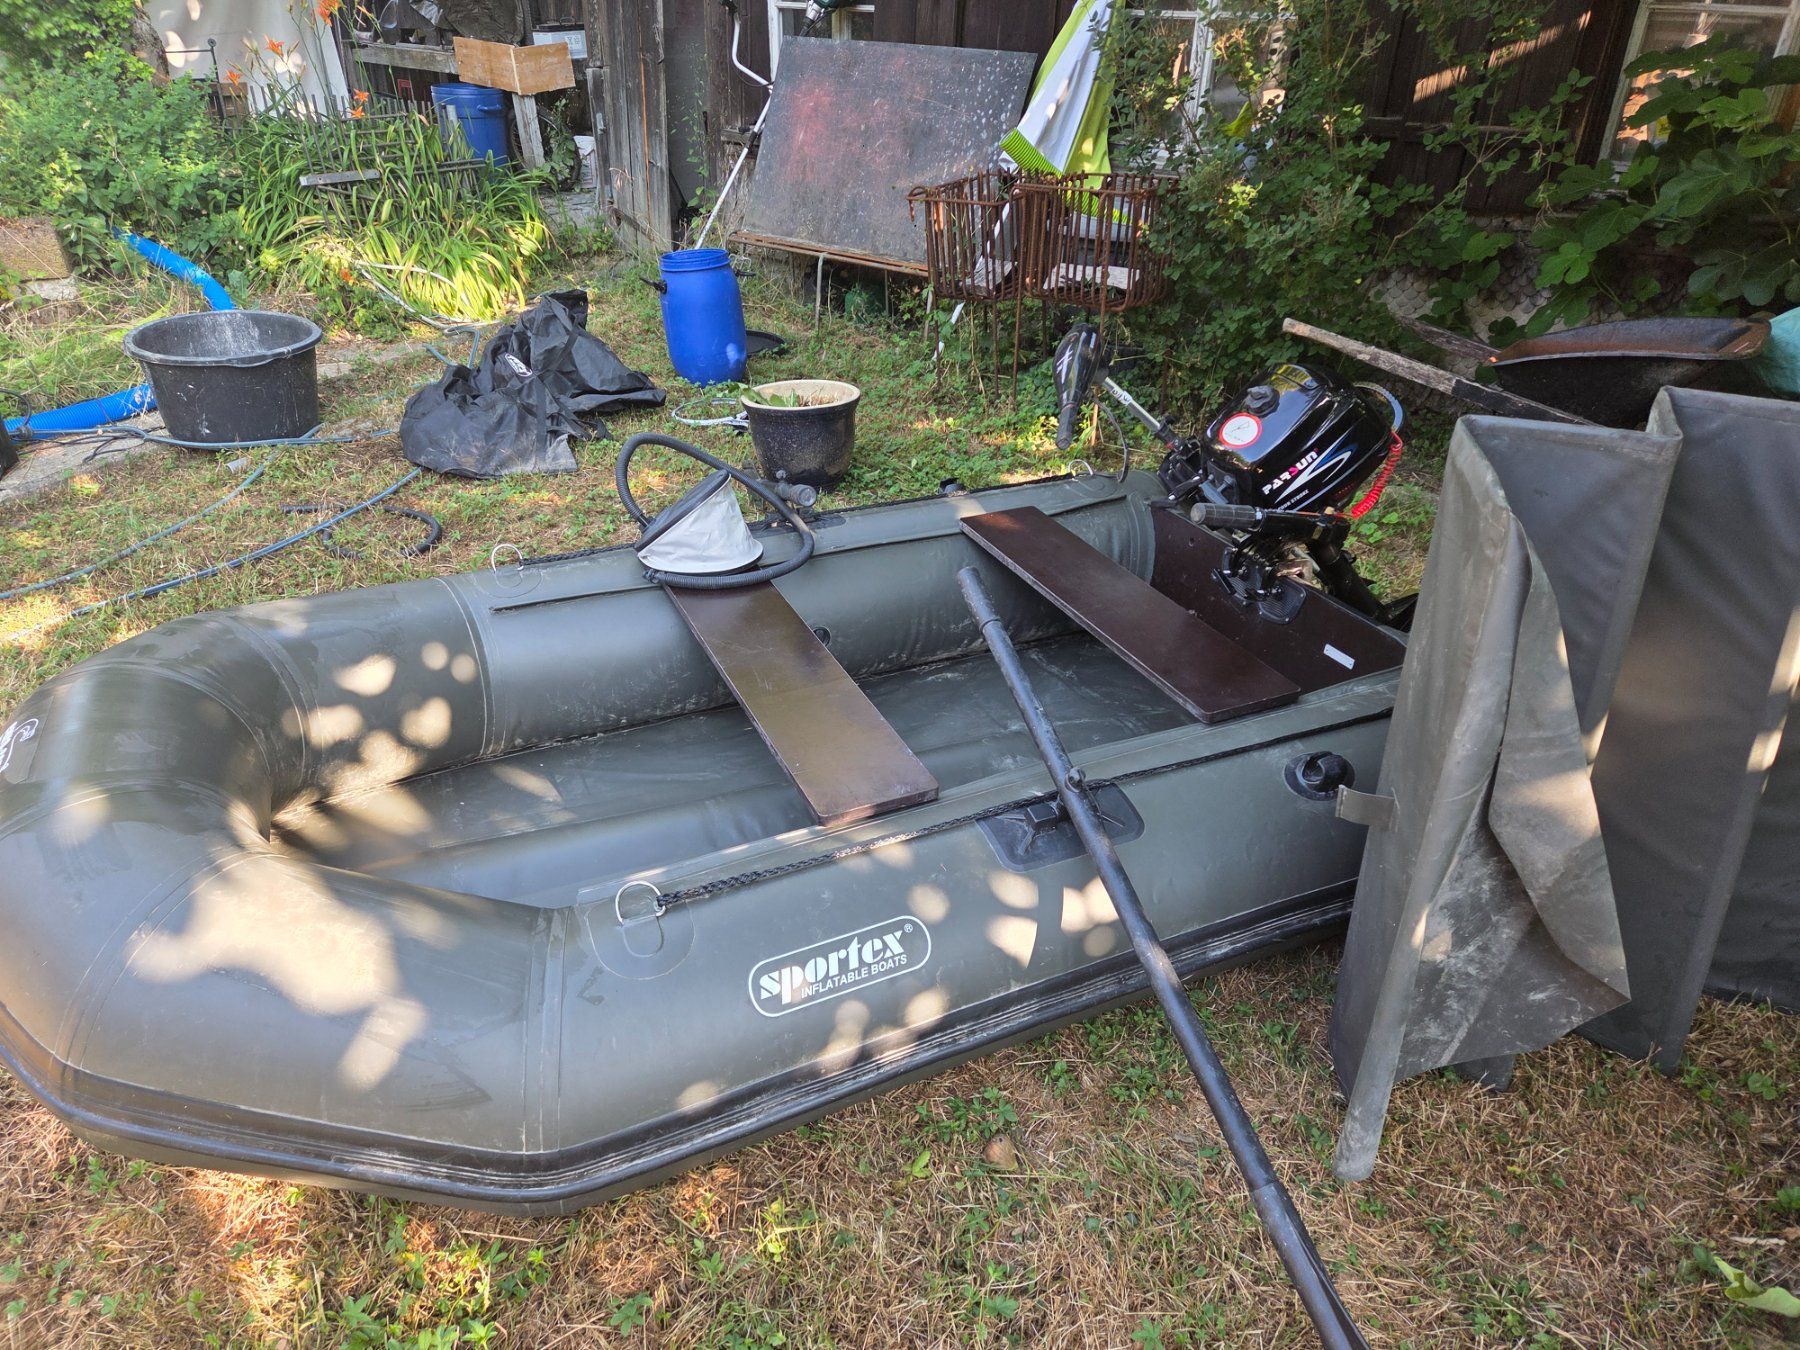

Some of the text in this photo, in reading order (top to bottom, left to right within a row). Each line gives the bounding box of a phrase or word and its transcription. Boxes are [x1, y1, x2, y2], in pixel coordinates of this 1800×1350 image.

[1262, 451, 1318, 495] PARSUN
[801, 954, 908, 999] INFLATABLE BOATS
